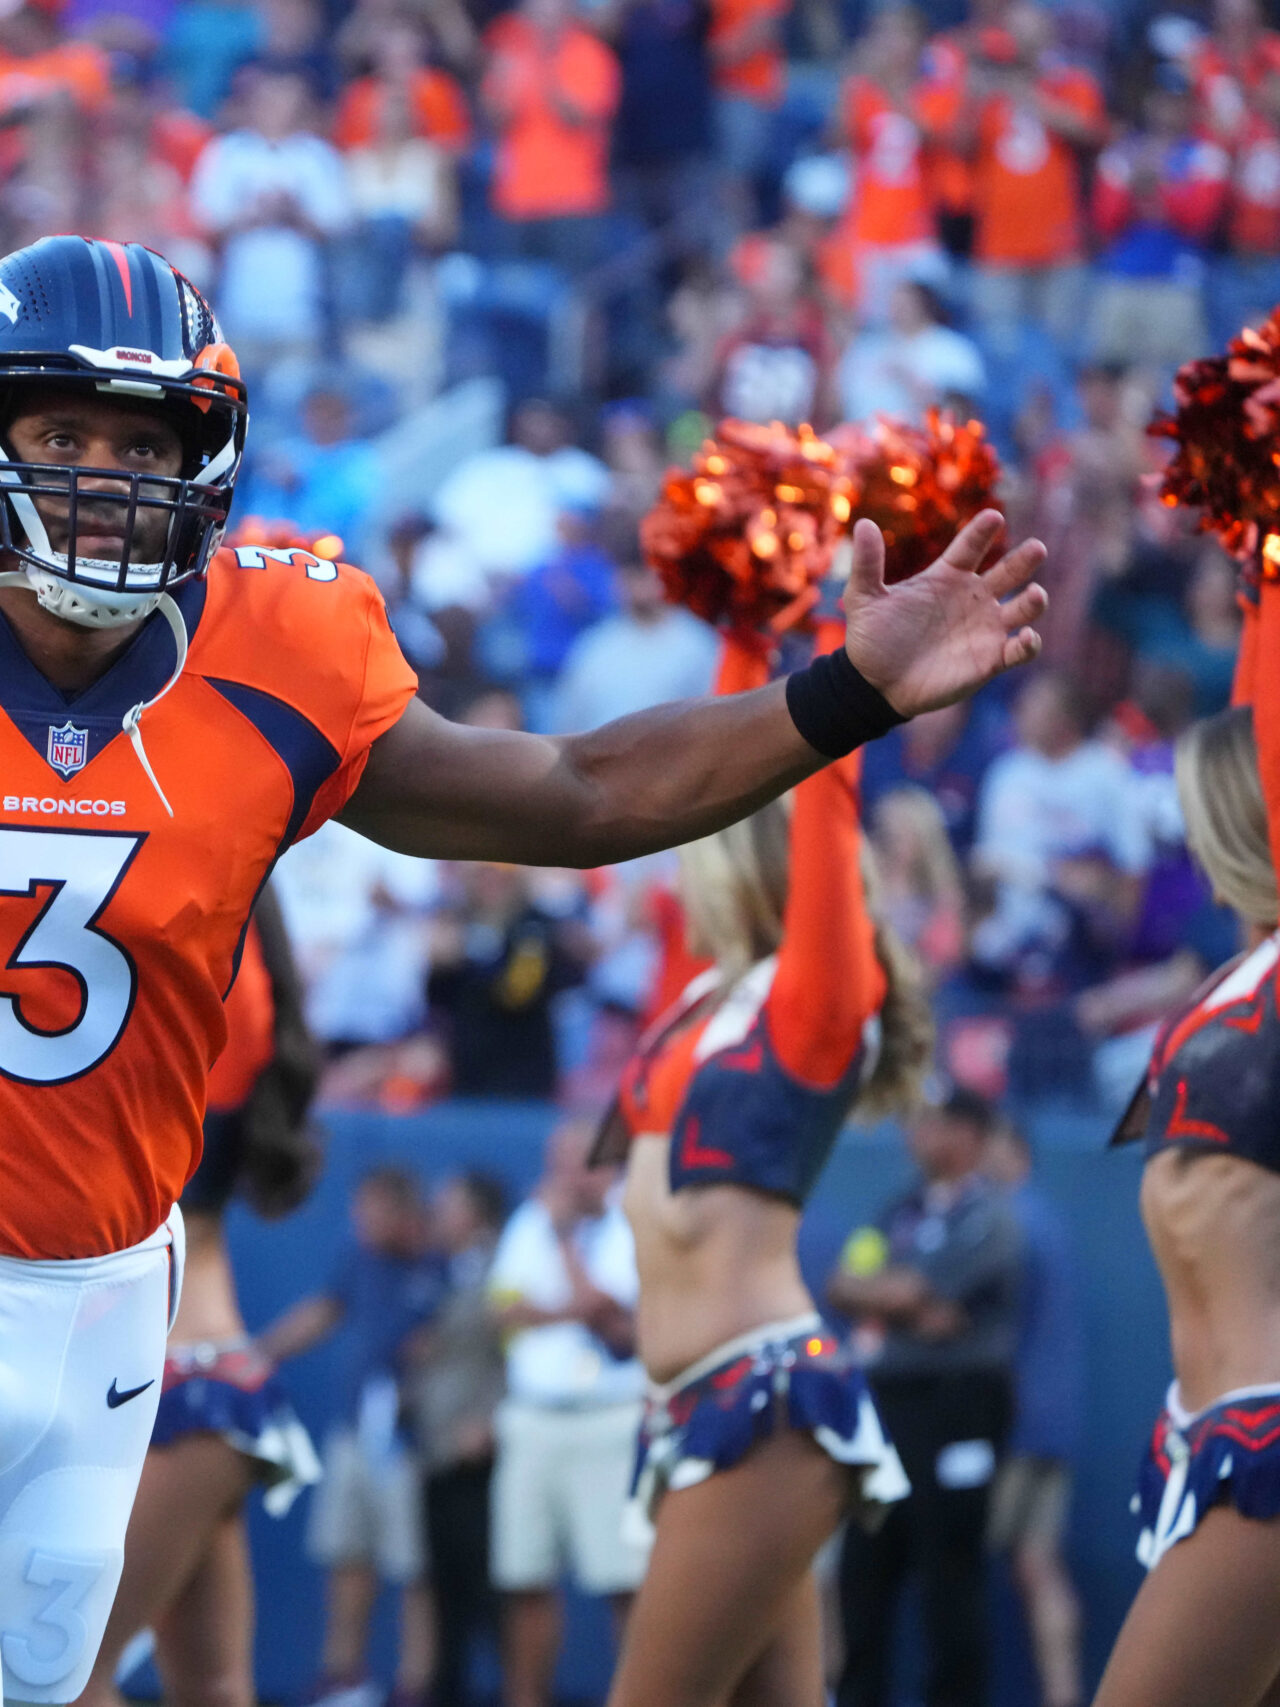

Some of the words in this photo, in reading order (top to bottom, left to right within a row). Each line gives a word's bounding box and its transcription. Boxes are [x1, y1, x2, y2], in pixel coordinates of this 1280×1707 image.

[115, 350, 152, 364] BRONCOS
[233, 545, 338, 582] 3
[53, 745, 81, 766] NFL
[3, 795, 127, 816] BRONCOS
[0, 1550, 105, 1687] 3
